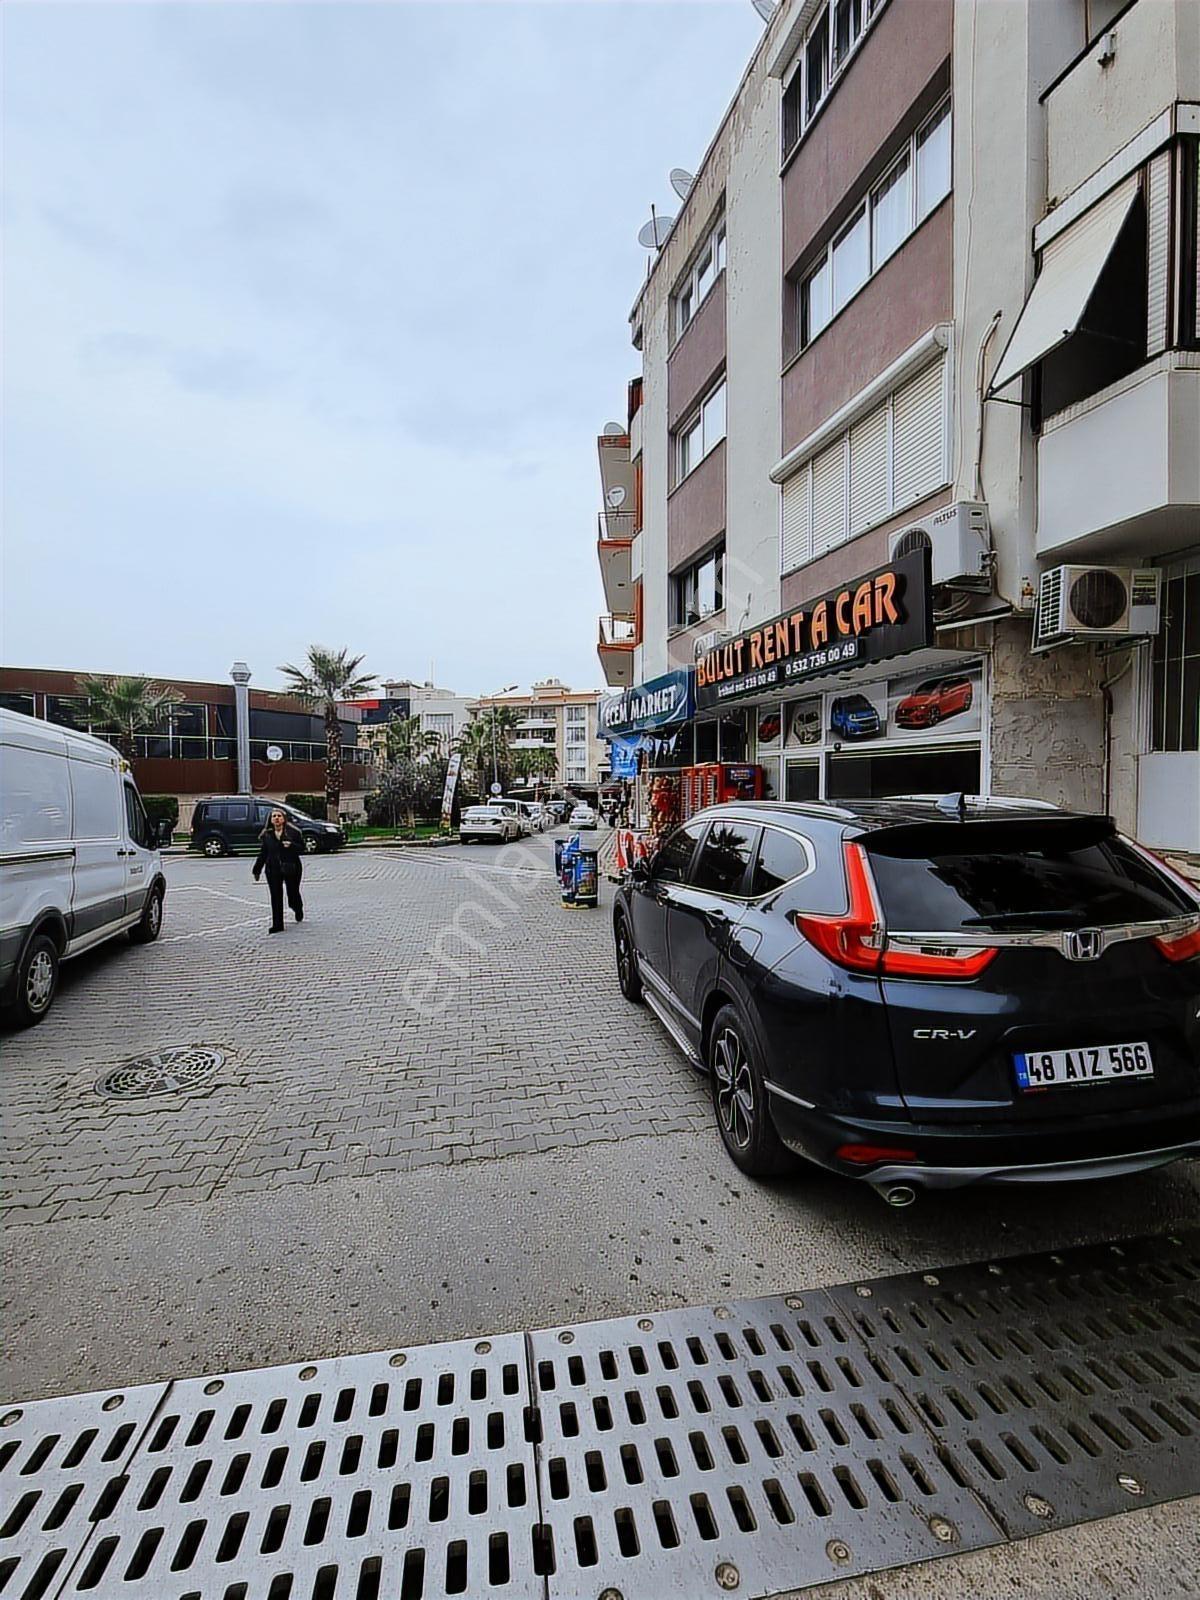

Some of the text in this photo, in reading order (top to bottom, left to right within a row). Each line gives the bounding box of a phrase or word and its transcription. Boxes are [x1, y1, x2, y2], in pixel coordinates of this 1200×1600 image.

[697, 572, 898, 687] BULUT RENT A CAR
[785, 643, 855, 675] 0 532 736 00 49
[630, 684, 677, 721] MARKET
[913, 1029, 977, 1040] CR-V
[1028, 1045, 1148, 1082] 48 AIZ 566
